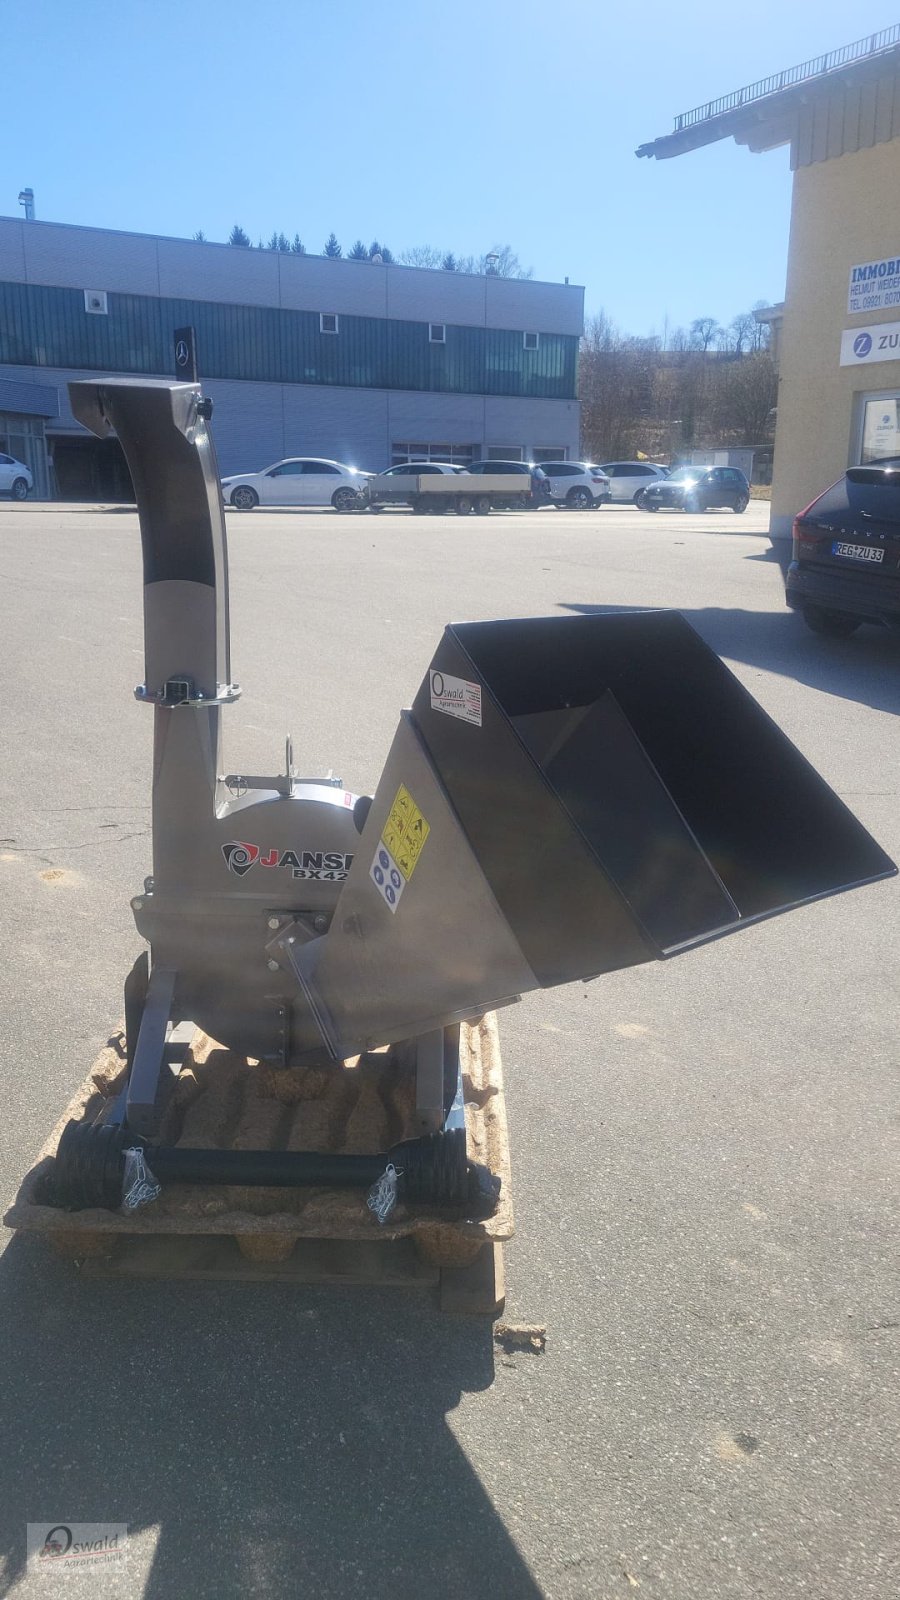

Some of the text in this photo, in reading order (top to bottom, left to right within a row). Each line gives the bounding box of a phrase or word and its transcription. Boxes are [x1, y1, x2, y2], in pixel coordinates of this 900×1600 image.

[850, 281, 876, 296] HELMUT
[878, 333, 900, 350] ZU
[829, 526, 885, 539] VOLVO
[432, 672, 464, 699] Oswald
[293, 869, 348, 881] BX42
